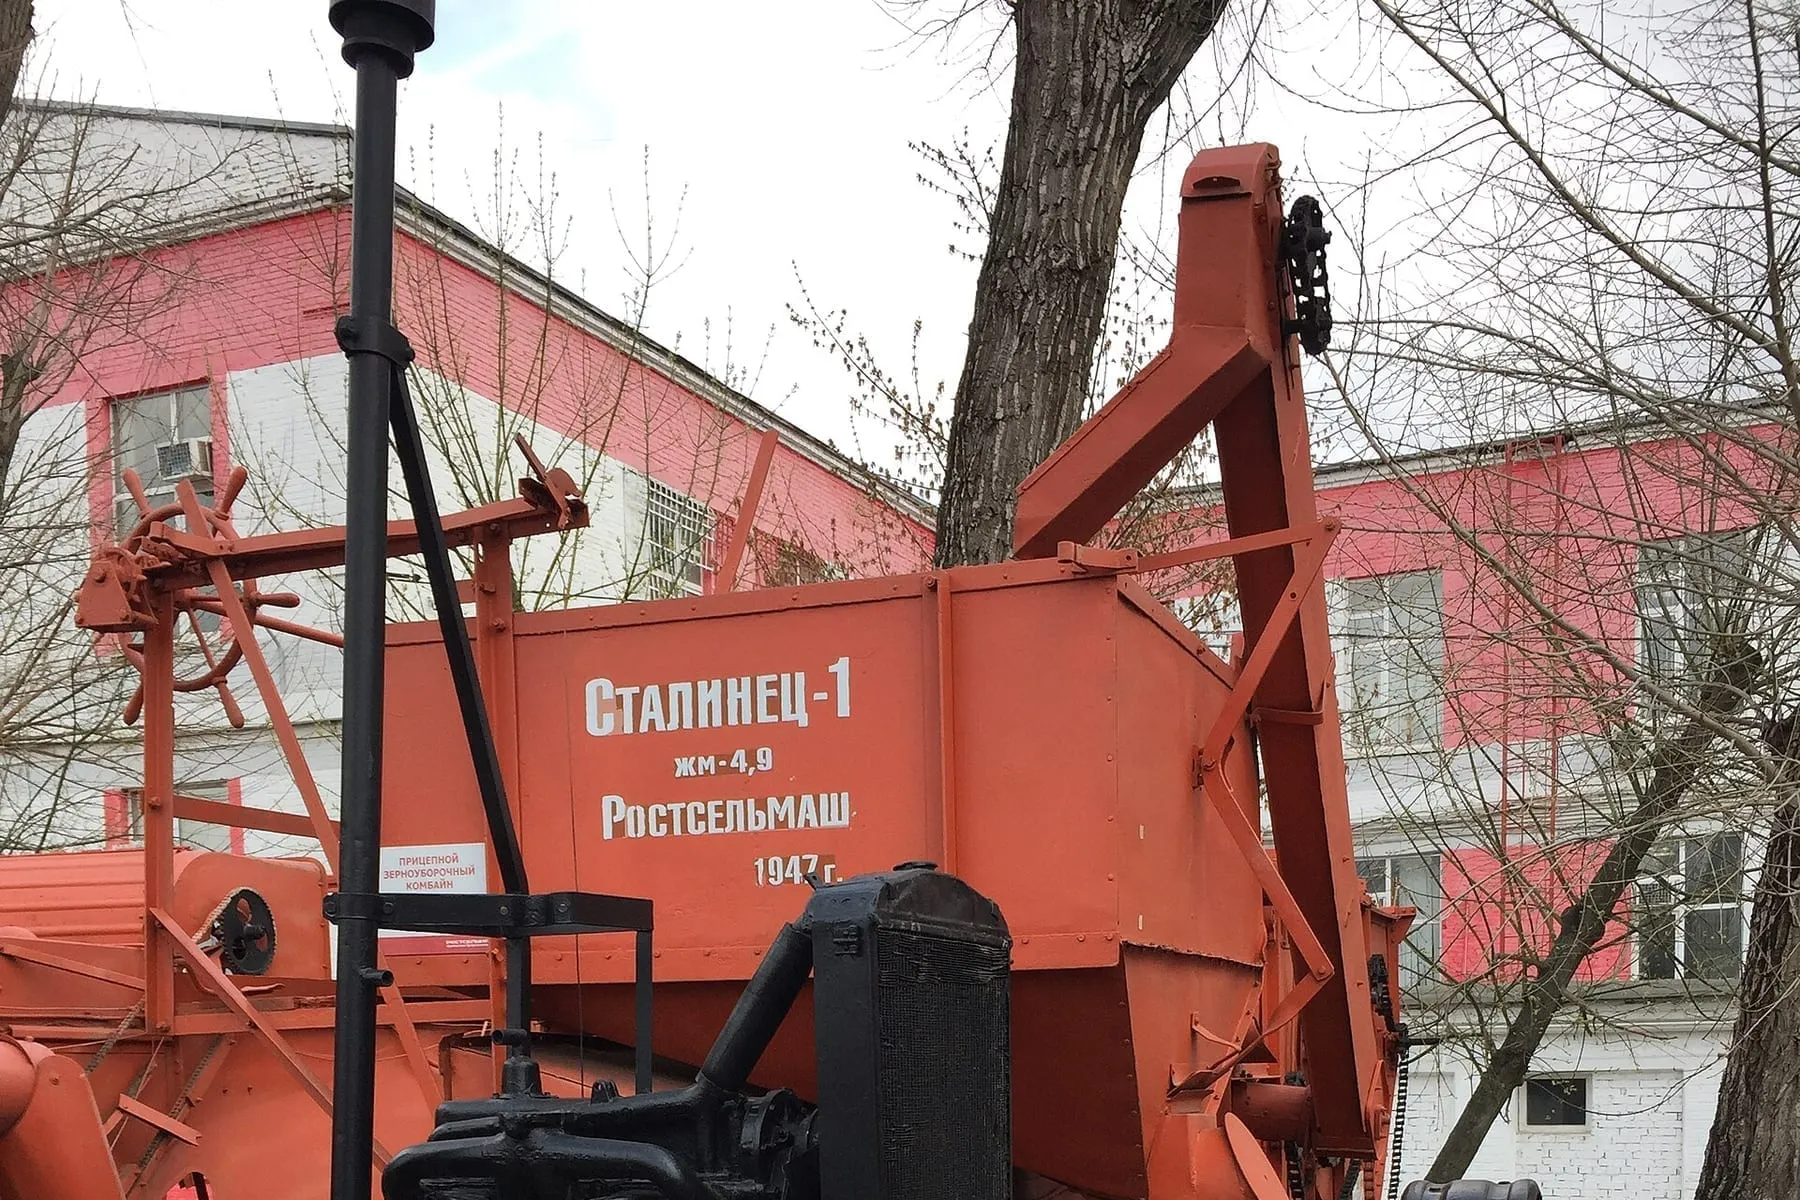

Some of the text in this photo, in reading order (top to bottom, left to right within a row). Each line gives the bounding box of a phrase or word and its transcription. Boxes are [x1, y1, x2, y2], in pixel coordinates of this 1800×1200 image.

[399, 853, 459, 866] ПРИЦЕПНОЙ
[383, 865, 475, 879] ЗЕРНОУБОРОЧНЫЙ
[754, 854, 819, 886] 1947
[406, 879, 454, 890] КОМБАЙН
